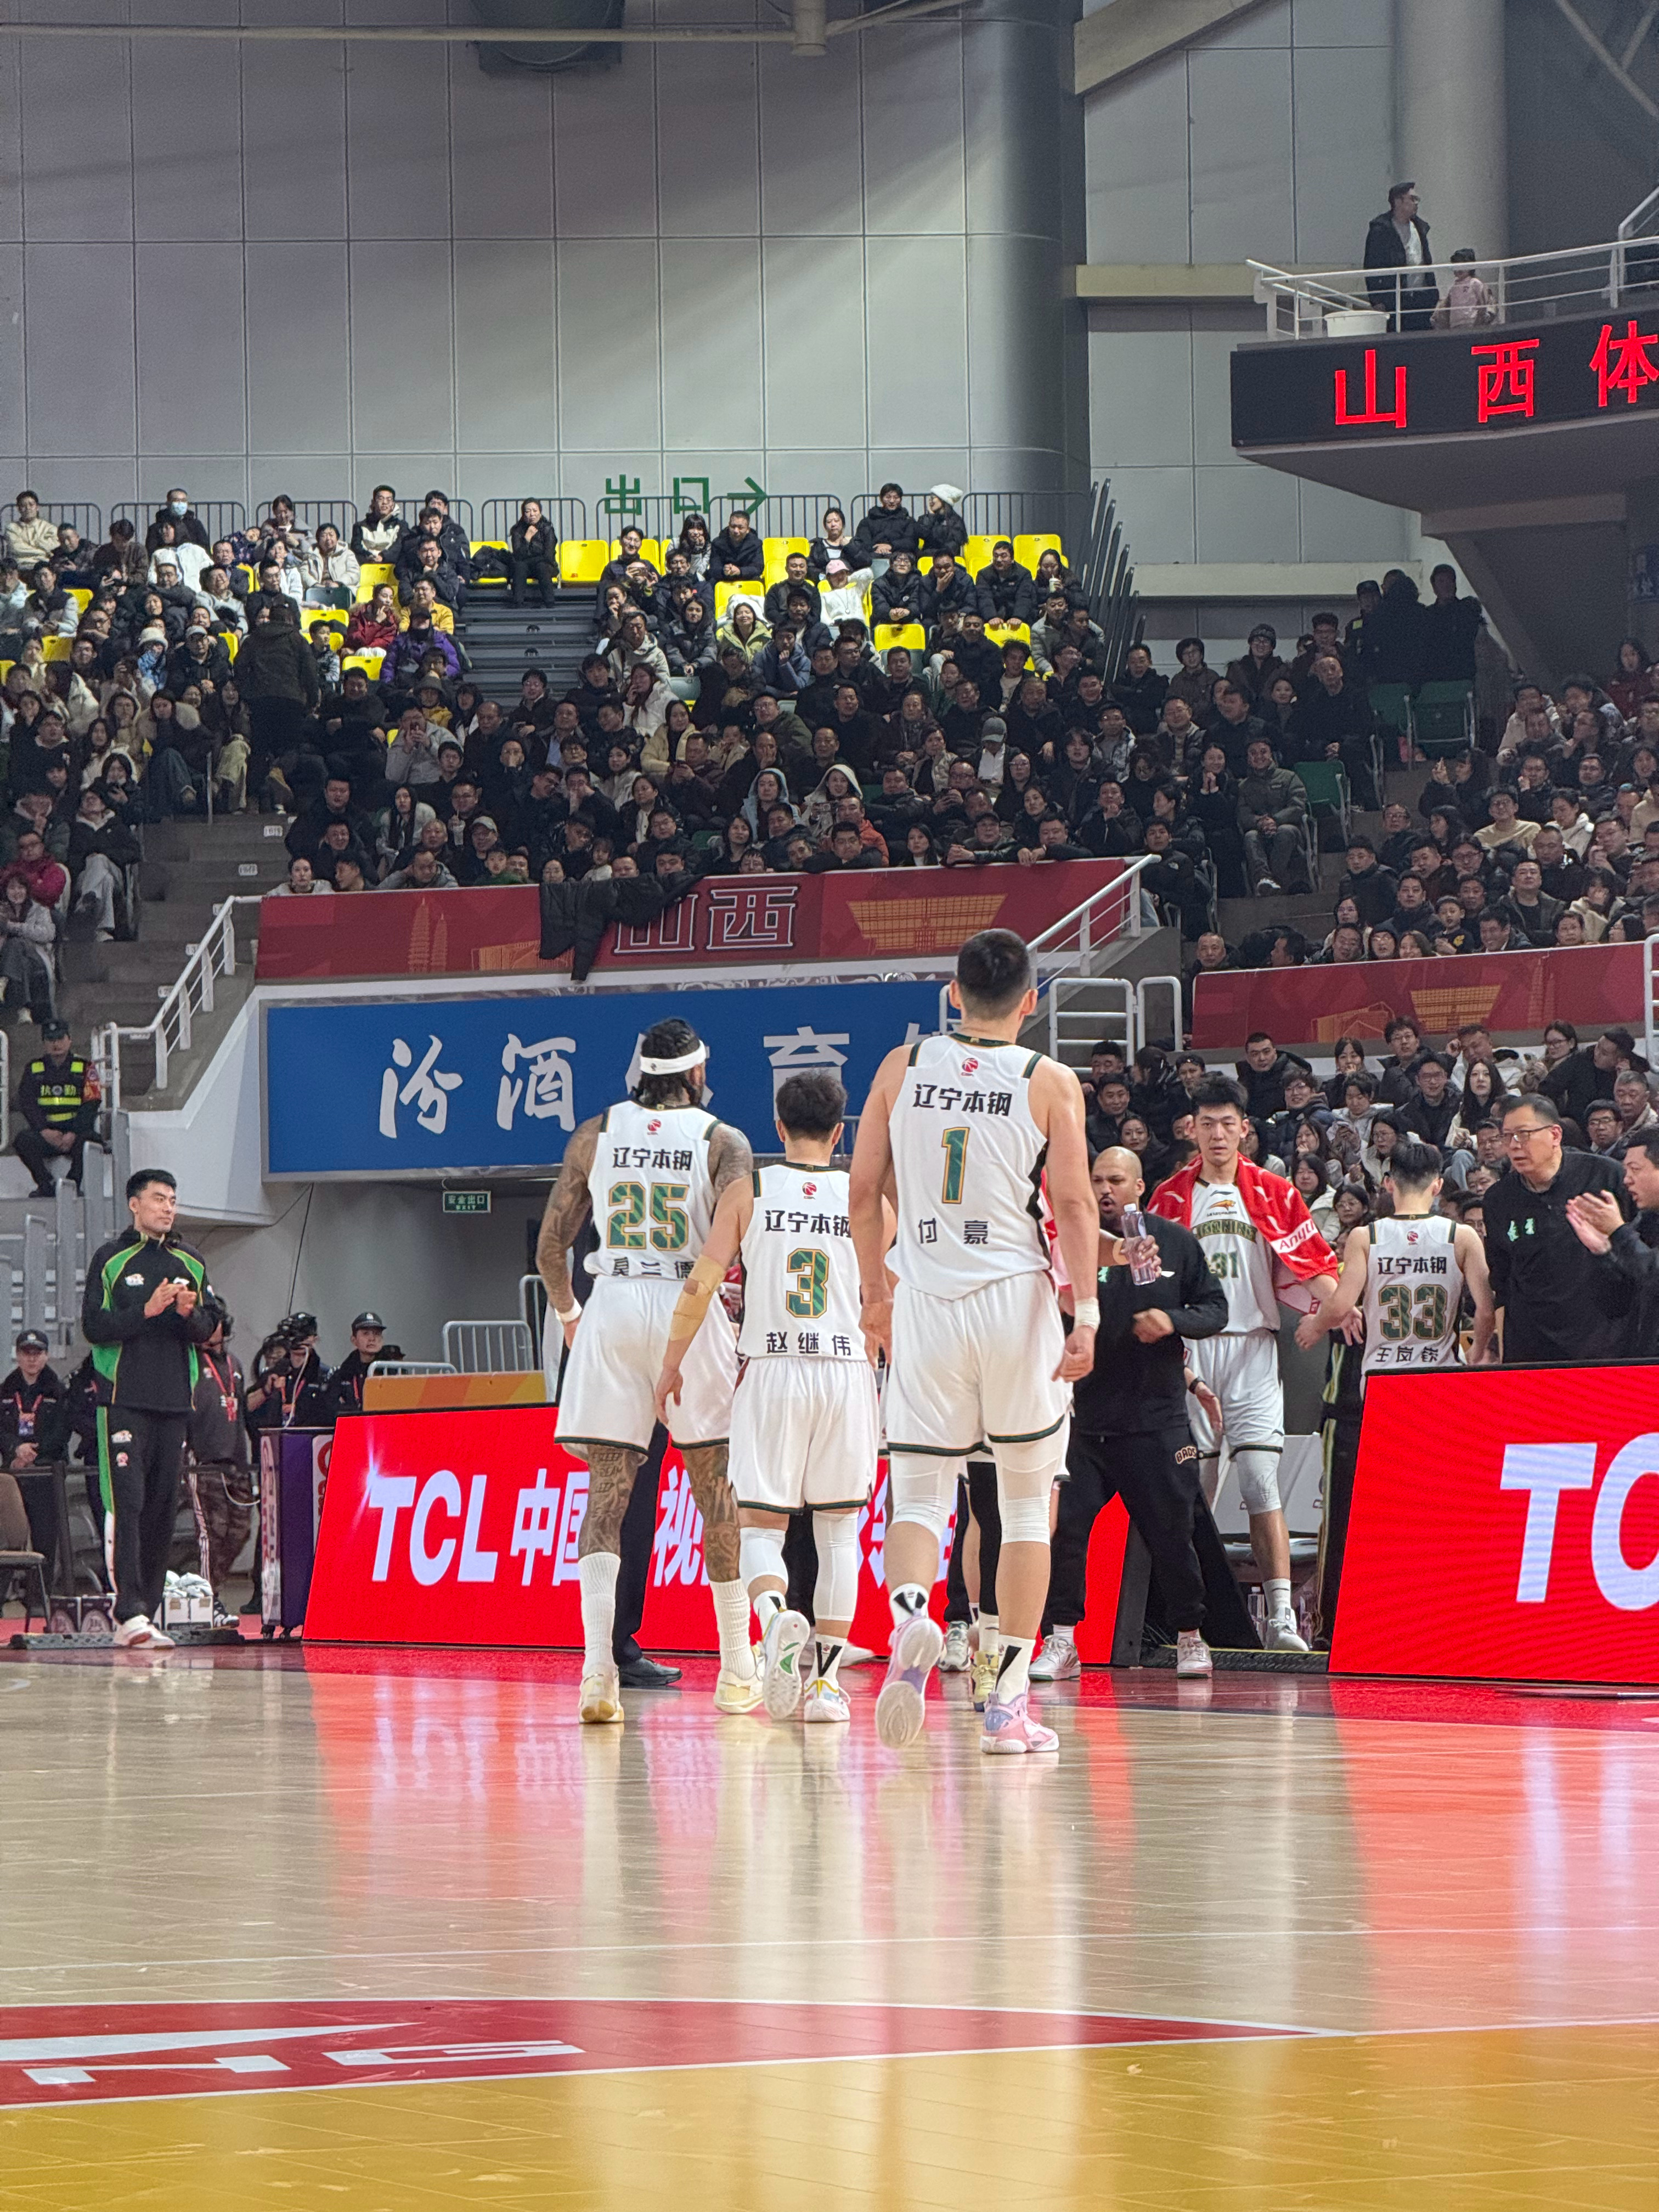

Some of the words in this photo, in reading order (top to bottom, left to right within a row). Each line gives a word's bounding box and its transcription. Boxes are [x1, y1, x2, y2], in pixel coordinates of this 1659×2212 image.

[1334, 320, 1659, 429] 山西体
[605, 474, 709, 515] 出口
[613, 885, 799, 954] 山西
[912, 1084, 1013, 1116] 辽宁本钢
[612, 1147, 692, 1171] 辽宁本钢
[941, 1126, 970, 1204] 1
[448, 1195, 485, 1204] 安全出口
[607, 1181, 690, 1251] 25
[765, 1210, 851, 1238] 辽宁本钢
[918, 1217, 989, 1245] 付豪
[786, 1248, 830, 1318] 3
[1377, 1256, 1447, 1274] 辽宁本钢
[1378, 1284, 1447, 1341] 33
[766, 1331, 851, 1356] 赵继伟
[368, 1470, 498, 1586] TCL
